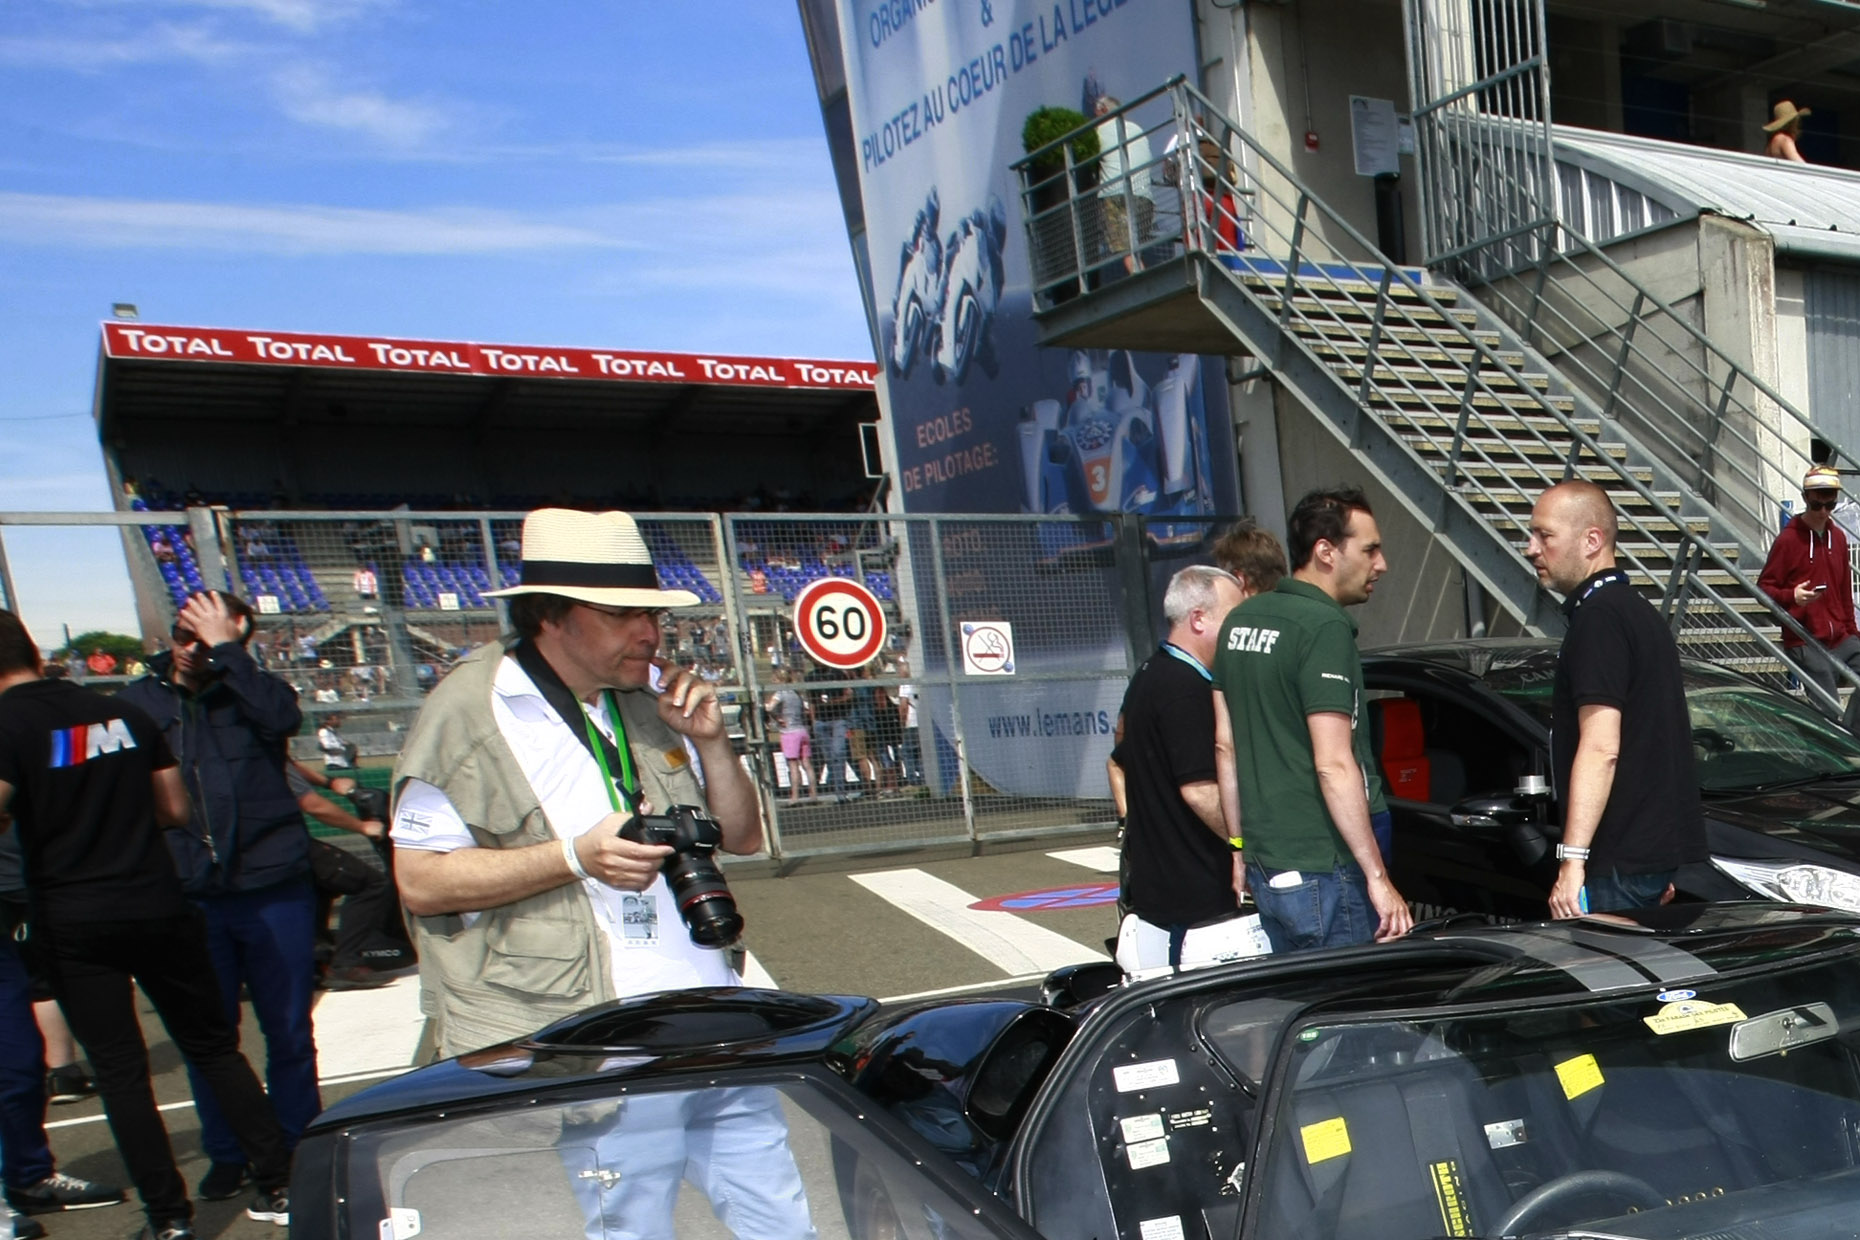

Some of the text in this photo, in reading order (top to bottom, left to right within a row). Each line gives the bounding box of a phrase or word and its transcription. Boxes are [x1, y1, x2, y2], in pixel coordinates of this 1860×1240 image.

[862, 99, 921, 174] PILOTEZ
[923, 85, 944, 132] AU
[949, 44, 1008, 113] COEUR
[1009, 22, 1038, 73] DE
[1040, 7, 1068, 51] LA
[118, 329, 233, 356] TOTAL
[247, 336, 355, 362] TOTAL
[368, 343, 470, 368] TOTAL
[480, 350, 578, 372] TOTAL
[591, 354, 685, 378] TOTAL
[697, 359, 785, 381] TOTAL
[794, 363, 875, 385] TOTAL
[916, 407, 973, 448] ECOLES
[903, 466, 921, 492] DE
[1091, 464, 1106, 493] 3
[815, 605, 865, 641] 60
[1227, 626, 1280, 654] STAFF
